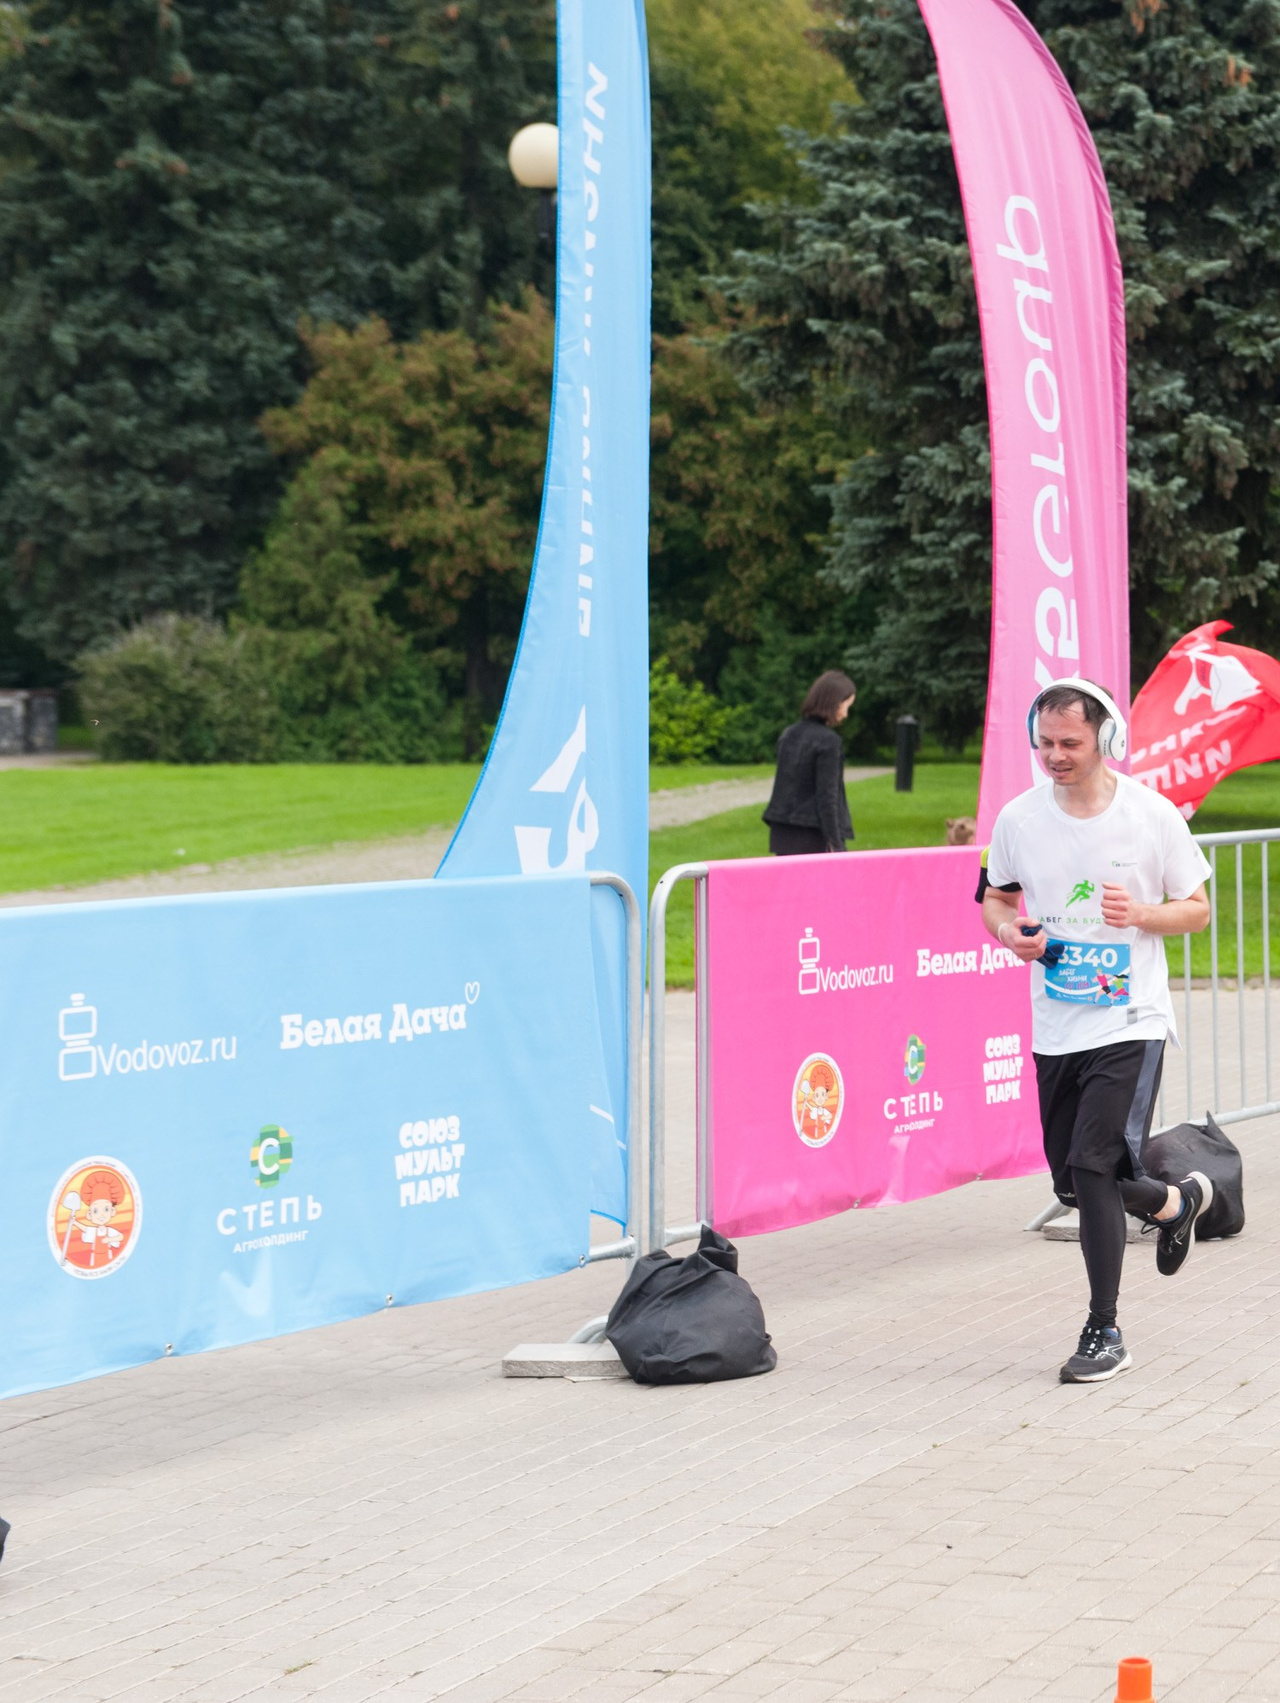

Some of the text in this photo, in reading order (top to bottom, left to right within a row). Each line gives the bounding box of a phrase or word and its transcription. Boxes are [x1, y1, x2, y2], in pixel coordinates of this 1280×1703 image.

[819, 963, 894, 993] Vodovoz.ru
[916, 948, 978, 977] Белая
[279, 1003, 468, 1050] Белая Дача
[97, 1035, 238, 1076] Vodovoz.ru
[984, 1034, 1021, 1059] СОЮЗ
[982, 1056, 1024, 1083] МУЛЬТ
[883, 1090, 944, 1120] СТЕПЬ
[985, 1080, 1022, 1105] ПАРК
[398, 1115, 461, 1149] СОЮЗ
[394, 1143, 466, 1180] МУЛЬТ
[399, 1173, 461, 1208] ПАРК
[216, 1194, 324, 1237] СТЕПЬ
